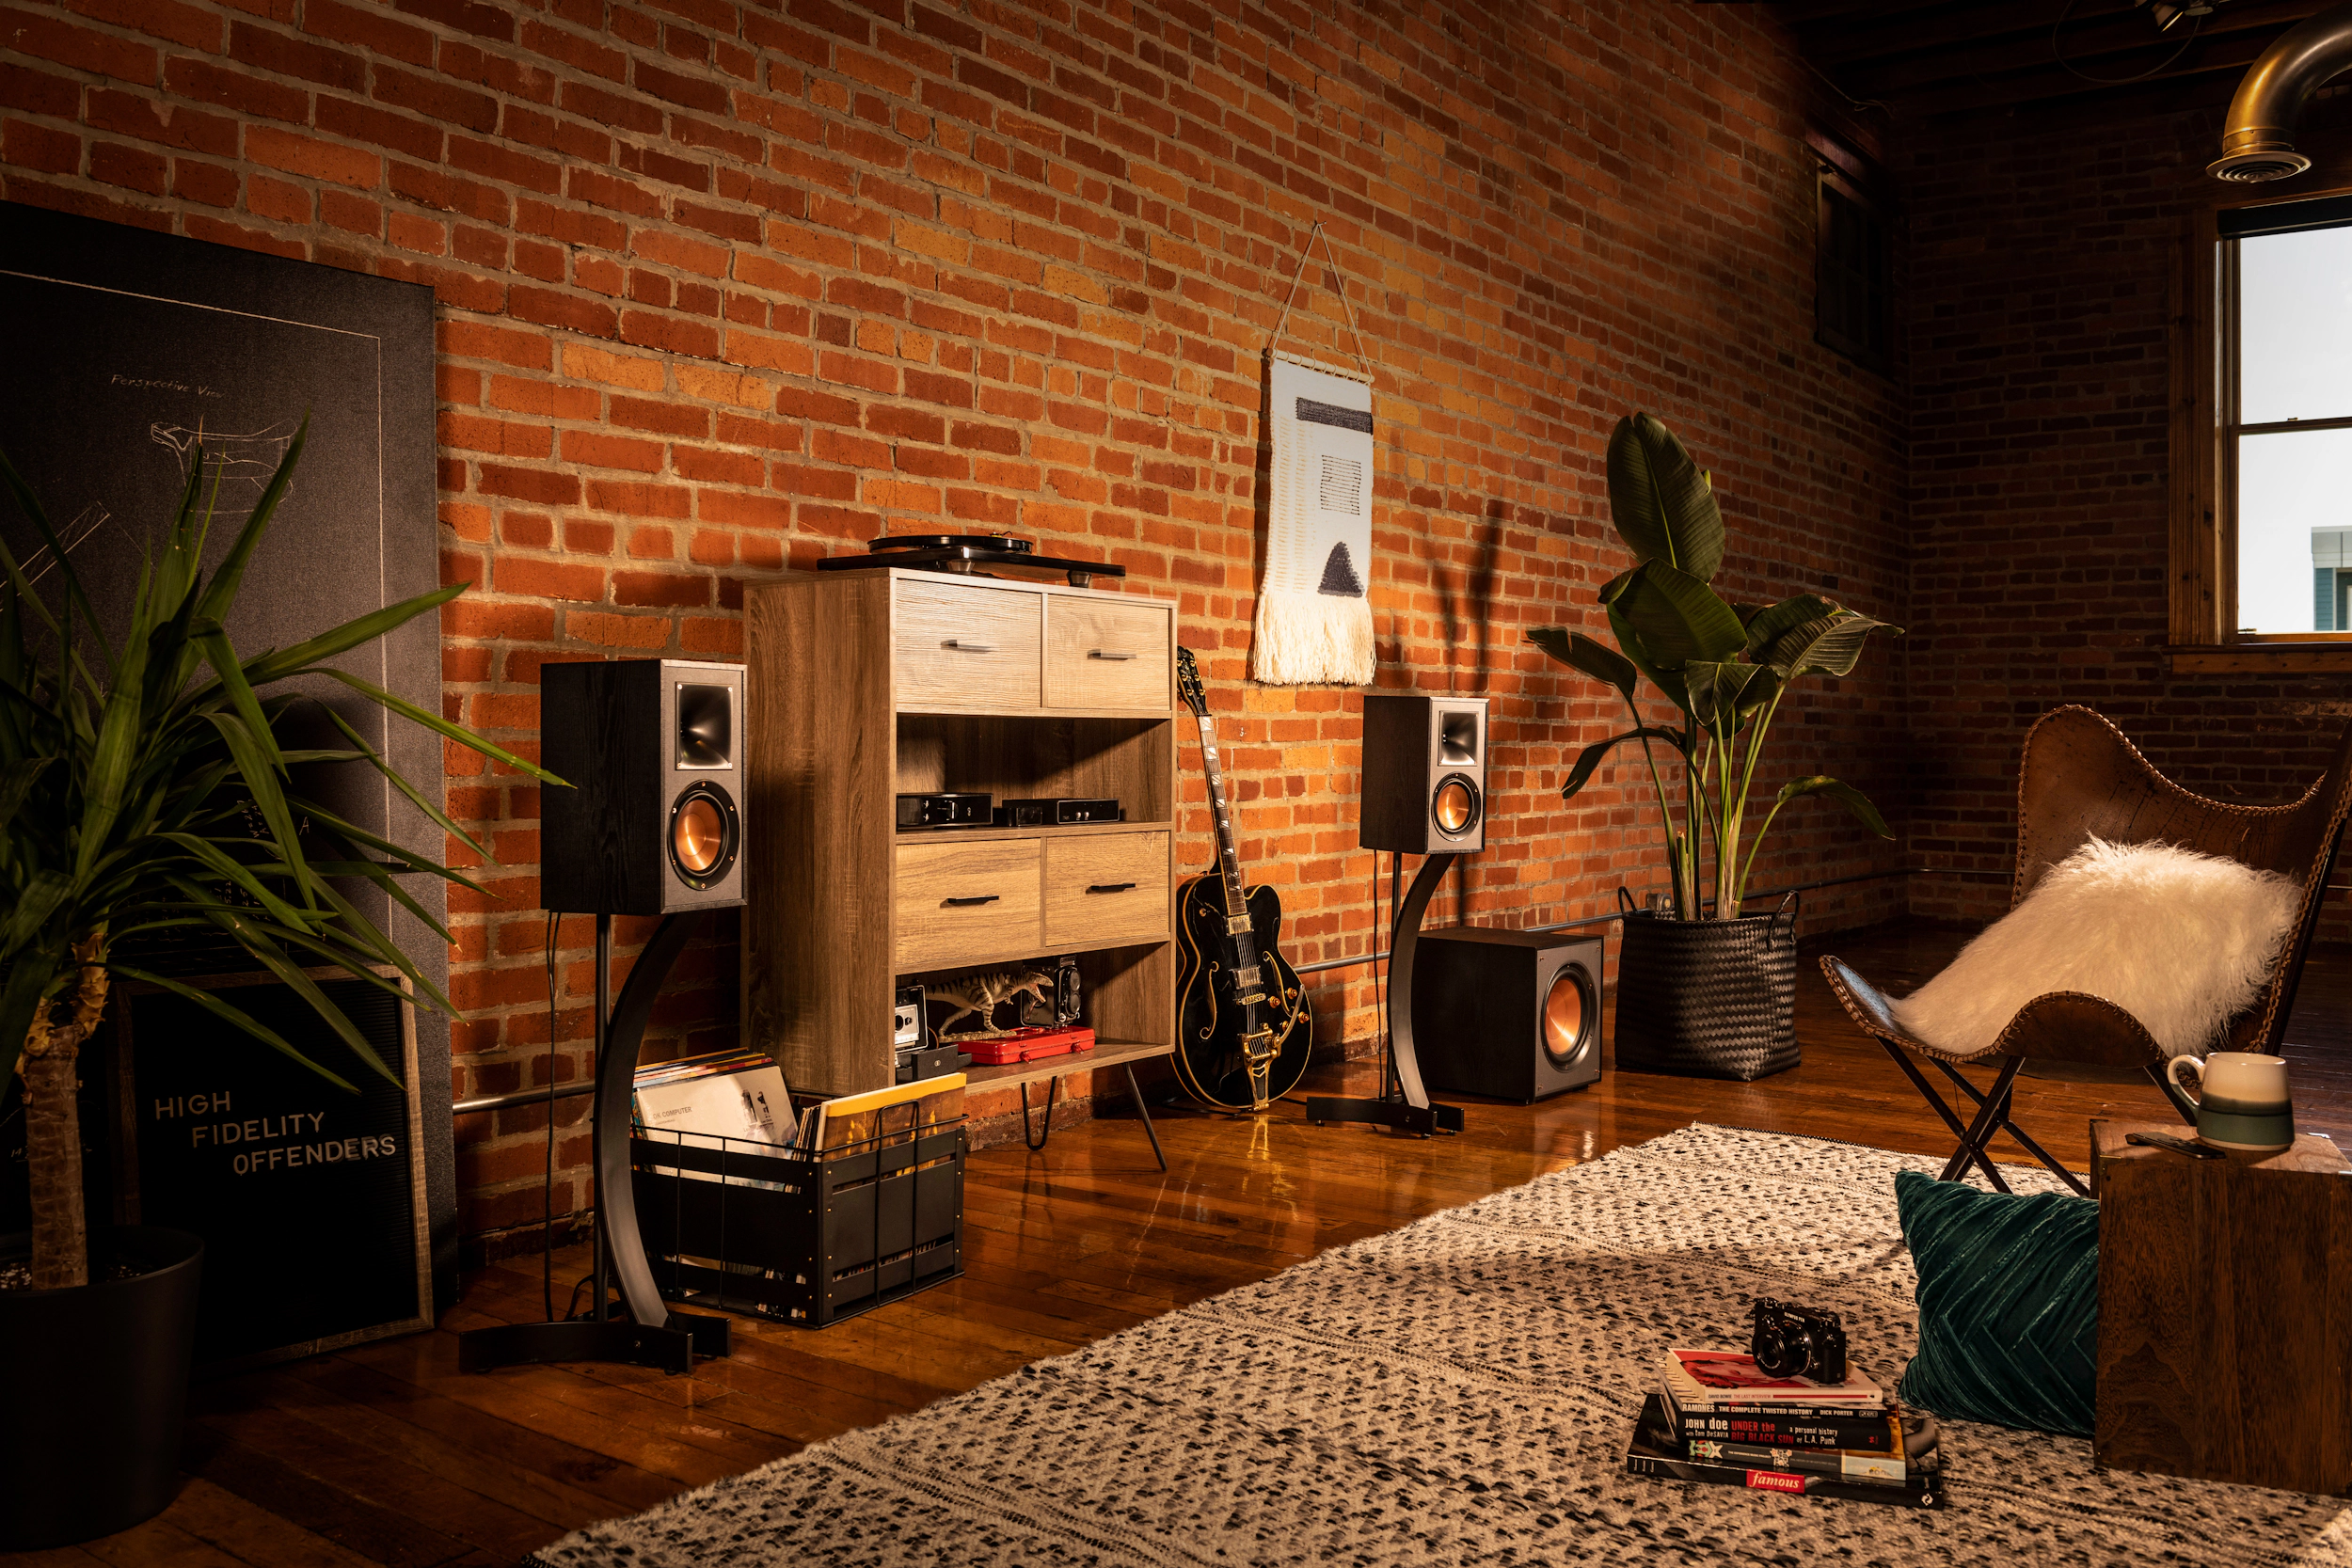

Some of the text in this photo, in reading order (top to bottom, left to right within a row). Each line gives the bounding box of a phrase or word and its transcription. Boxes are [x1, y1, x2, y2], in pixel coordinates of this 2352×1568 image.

[110, 373, 189, 392] Perspective
[154, 1091, 231, 1120] HIGH
[661, 1106, 692, 1117] COMPUTER
[192, 1112, 325, 1148] FIDELITY
[233, 1135, 396, 1176] OFFENDERS
[1682, 1403, 1715, 1413] RAMONES
[1685, 1417, 1728, 1430] JOHN doe
[1731, 1419, 1775, 1433] UNDER the
[1706, 1430, 1729, 1438] DeSAVIA
[1794, 1426, 1818, 1434] personal
[1818, 1427, 1838, 1437] history
[1731, 1432, 1794, 1445] BIG BLACK SUN
[1804, 1434, 1818, 1445] L.A.
[1820, 1435, 1836, 1446] Punk
[1751, 1472, 1800, 1488] famous
